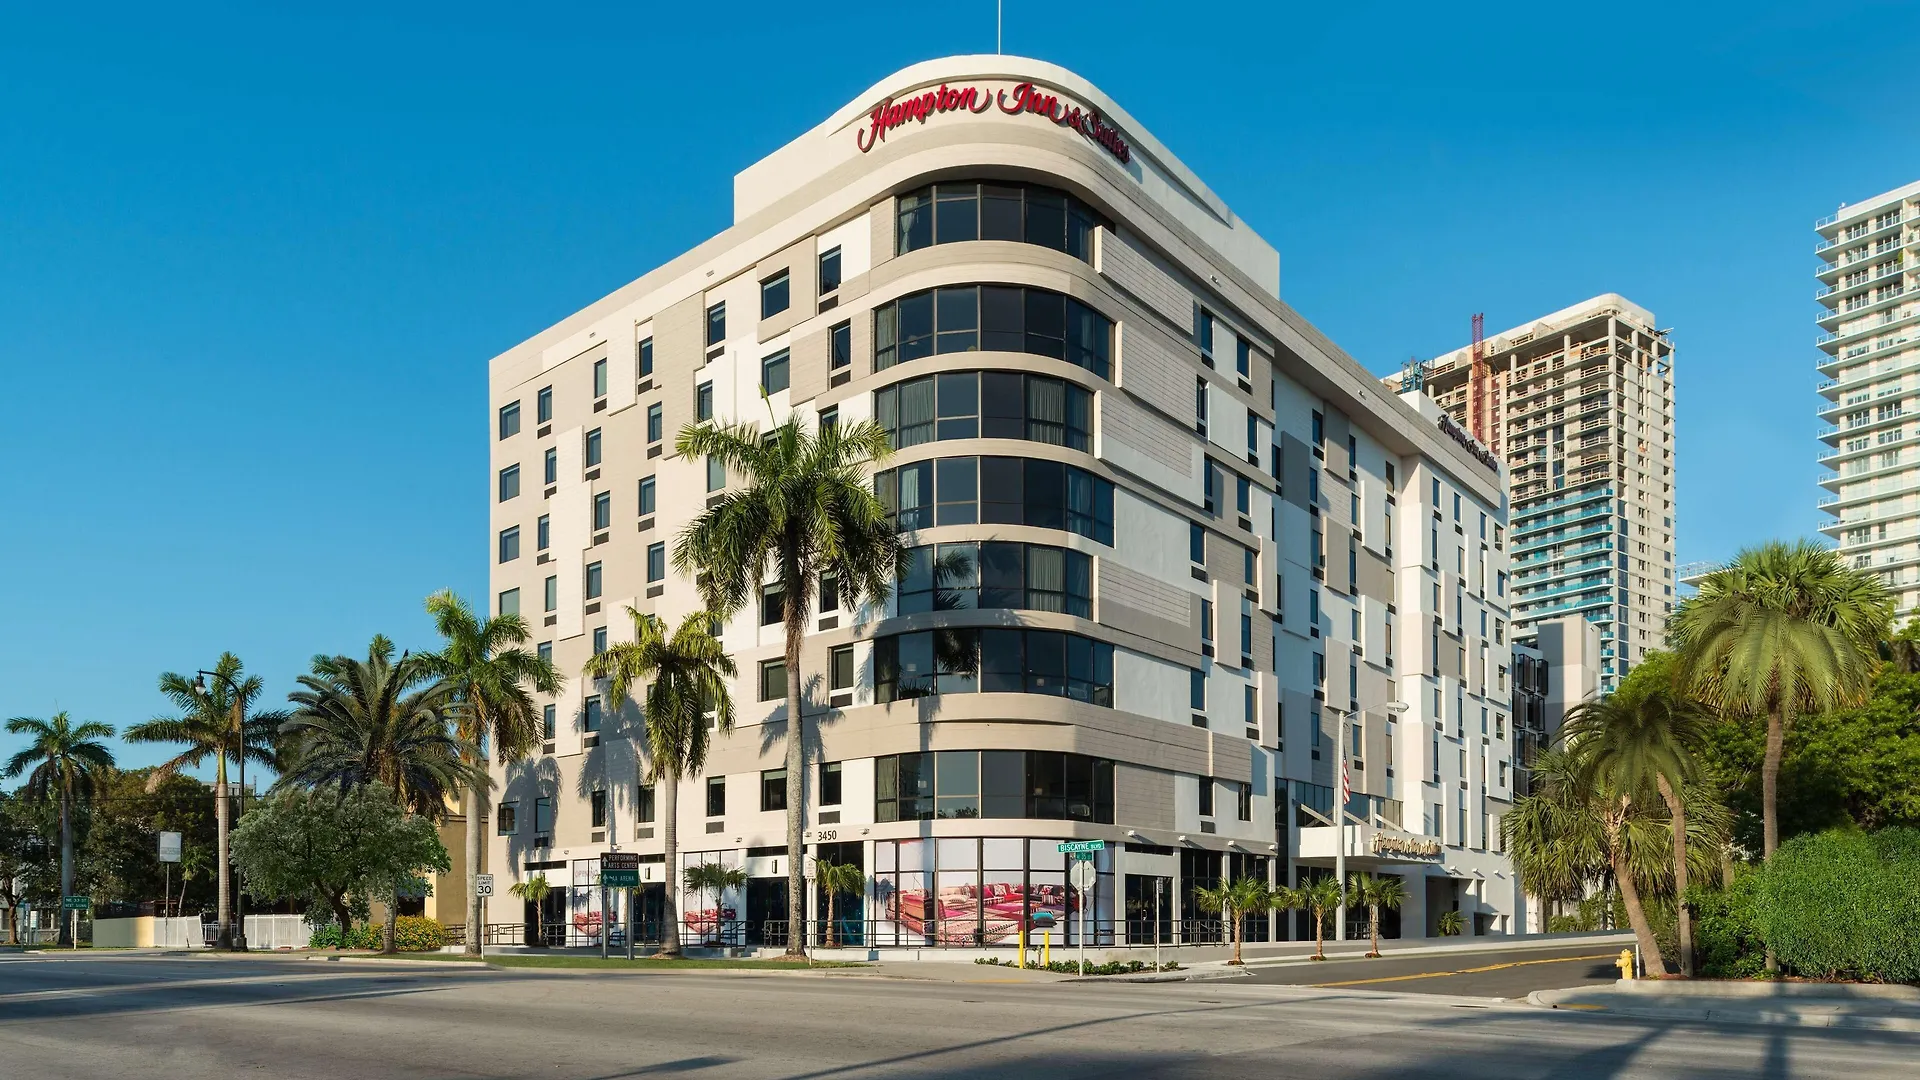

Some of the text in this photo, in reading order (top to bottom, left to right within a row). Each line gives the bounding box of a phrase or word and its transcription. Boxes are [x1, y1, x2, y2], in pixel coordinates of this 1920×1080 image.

[857, 82, 1130, 164] Hampton Inn & Suites
[817, 830, 837, 841] 3450
[1060, 842, 1089, 852] BISCAYNE
[478, 885, 491, 894] 30
